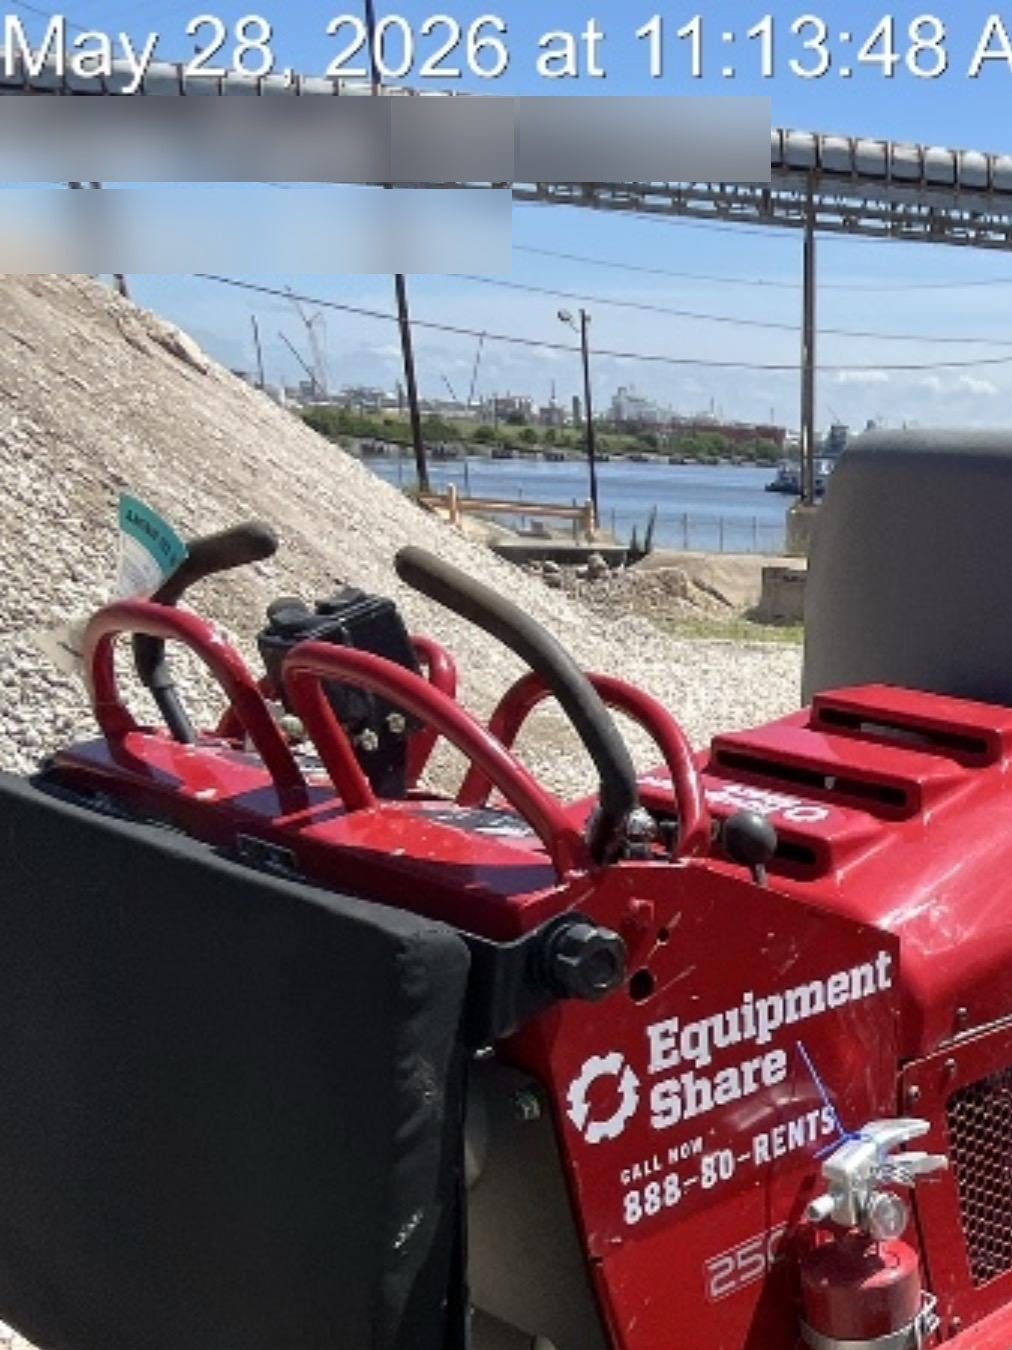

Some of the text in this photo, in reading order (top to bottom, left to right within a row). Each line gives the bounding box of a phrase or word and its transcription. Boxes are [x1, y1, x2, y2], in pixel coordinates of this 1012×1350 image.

[645, 949, 893, 1074] Equipment
[648, 1048, 788, 1130] Share
[620, 1136, 703, 1186] CALL NOW
[623, 1105, 837, 1227] 888-80-RENTS
